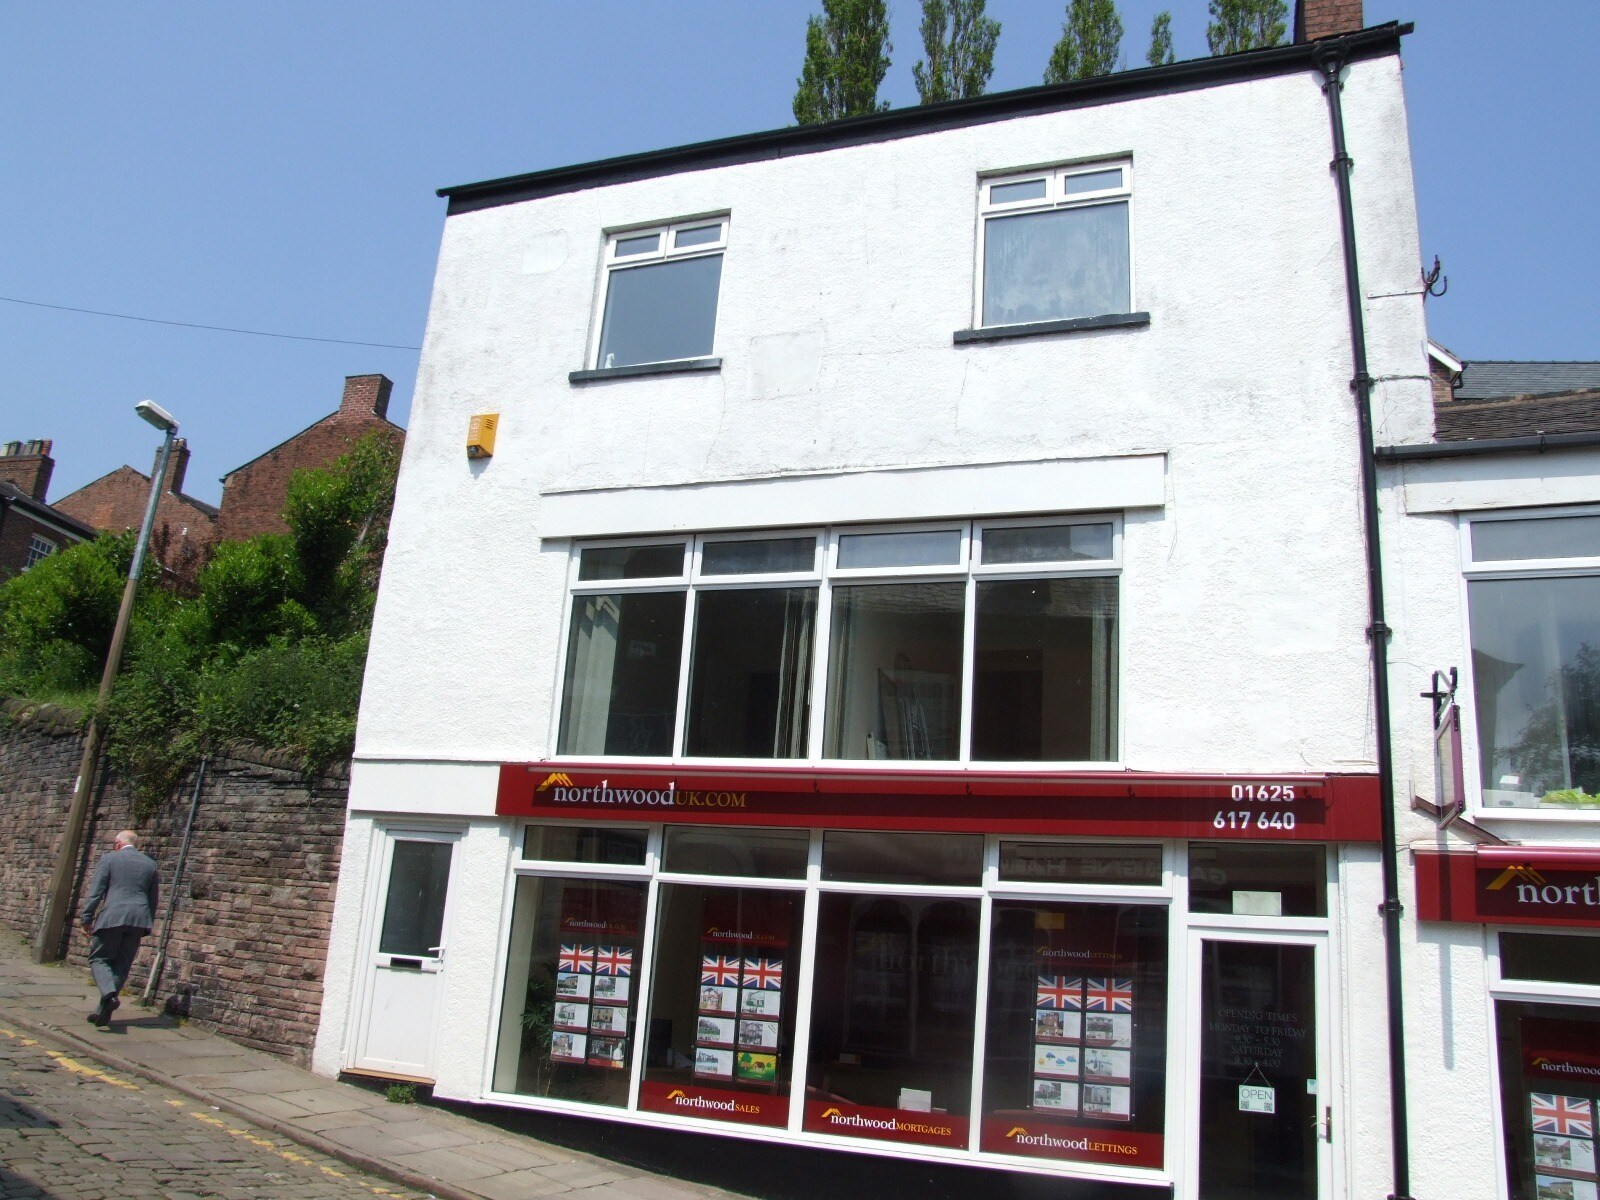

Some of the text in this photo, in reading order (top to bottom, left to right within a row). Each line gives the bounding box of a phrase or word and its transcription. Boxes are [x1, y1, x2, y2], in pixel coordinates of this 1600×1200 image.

[1231, 784, 1295, 801] 01625
[1213, 811, 1295, 830] 617 640
[1218, 1008, 1298, 1022] OPENING TIMES
[1209, 1022, 1307, 1038] MONDAY TO FRIDAY
[1231, 1046, 1284, 1057] SATURDAY
[1241, 1088, 1273, 1101] OPEN
